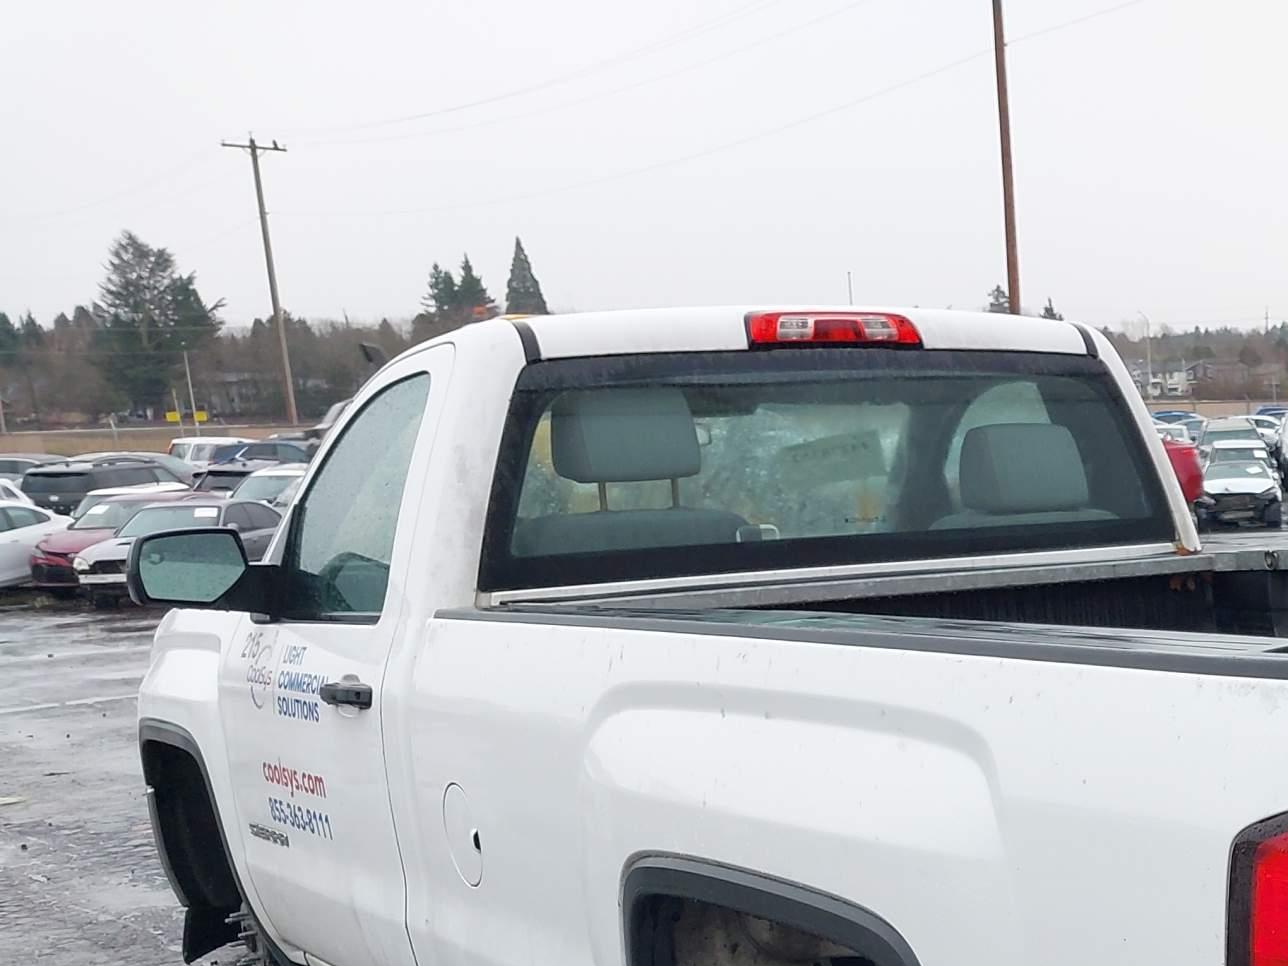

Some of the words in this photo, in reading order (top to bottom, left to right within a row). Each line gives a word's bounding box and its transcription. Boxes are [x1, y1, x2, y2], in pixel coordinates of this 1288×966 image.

[241, 631, 264, 659] 215
[283, 645, 308, 666] LIGHT
[277, 695, 321, 723] SOLUTIONS
[262, 756, 327, 799] coolsys.com
[268, 796, 334, 841] 855-363-8111
